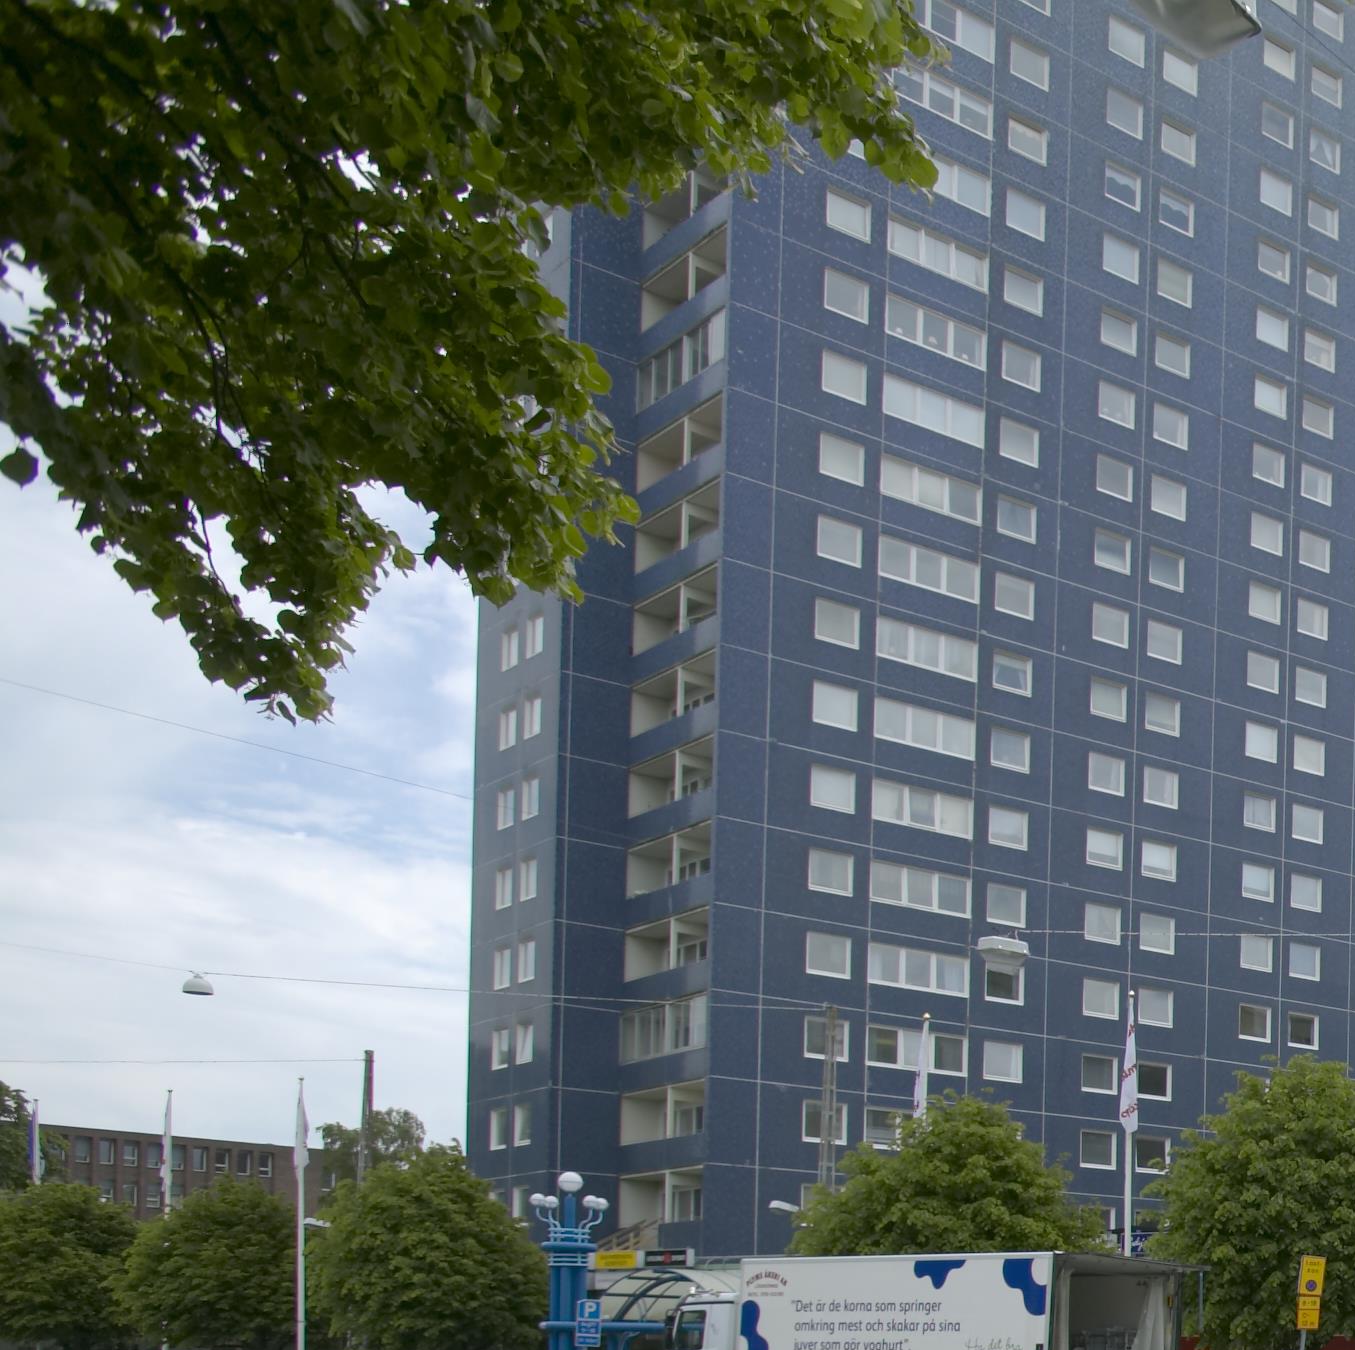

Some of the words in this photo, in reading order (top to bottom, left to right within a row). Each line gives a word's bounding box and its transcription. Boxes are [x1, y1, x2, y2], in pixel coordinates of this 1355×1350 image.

[584, 1302, 597, 1318] P
[815, 1299, 826, 1312] är
[829, 1299, 841, 1312] de
[843, 1299, 872, 1312] korna
[875, 1302, 896, 1312] som
[899, 1299, 942, 1316] springer
[794, 1318, 835, 1335] omkring
[838, 1319, 862, 1331] mest
[865, 1318, 884, 1332] och
[886, 1318, 920, 1332] skakar
[922, 1318, 936, 1335] på
[938, 1319, 961, 1332] sina
[820, 1341, 840, 1350] som
